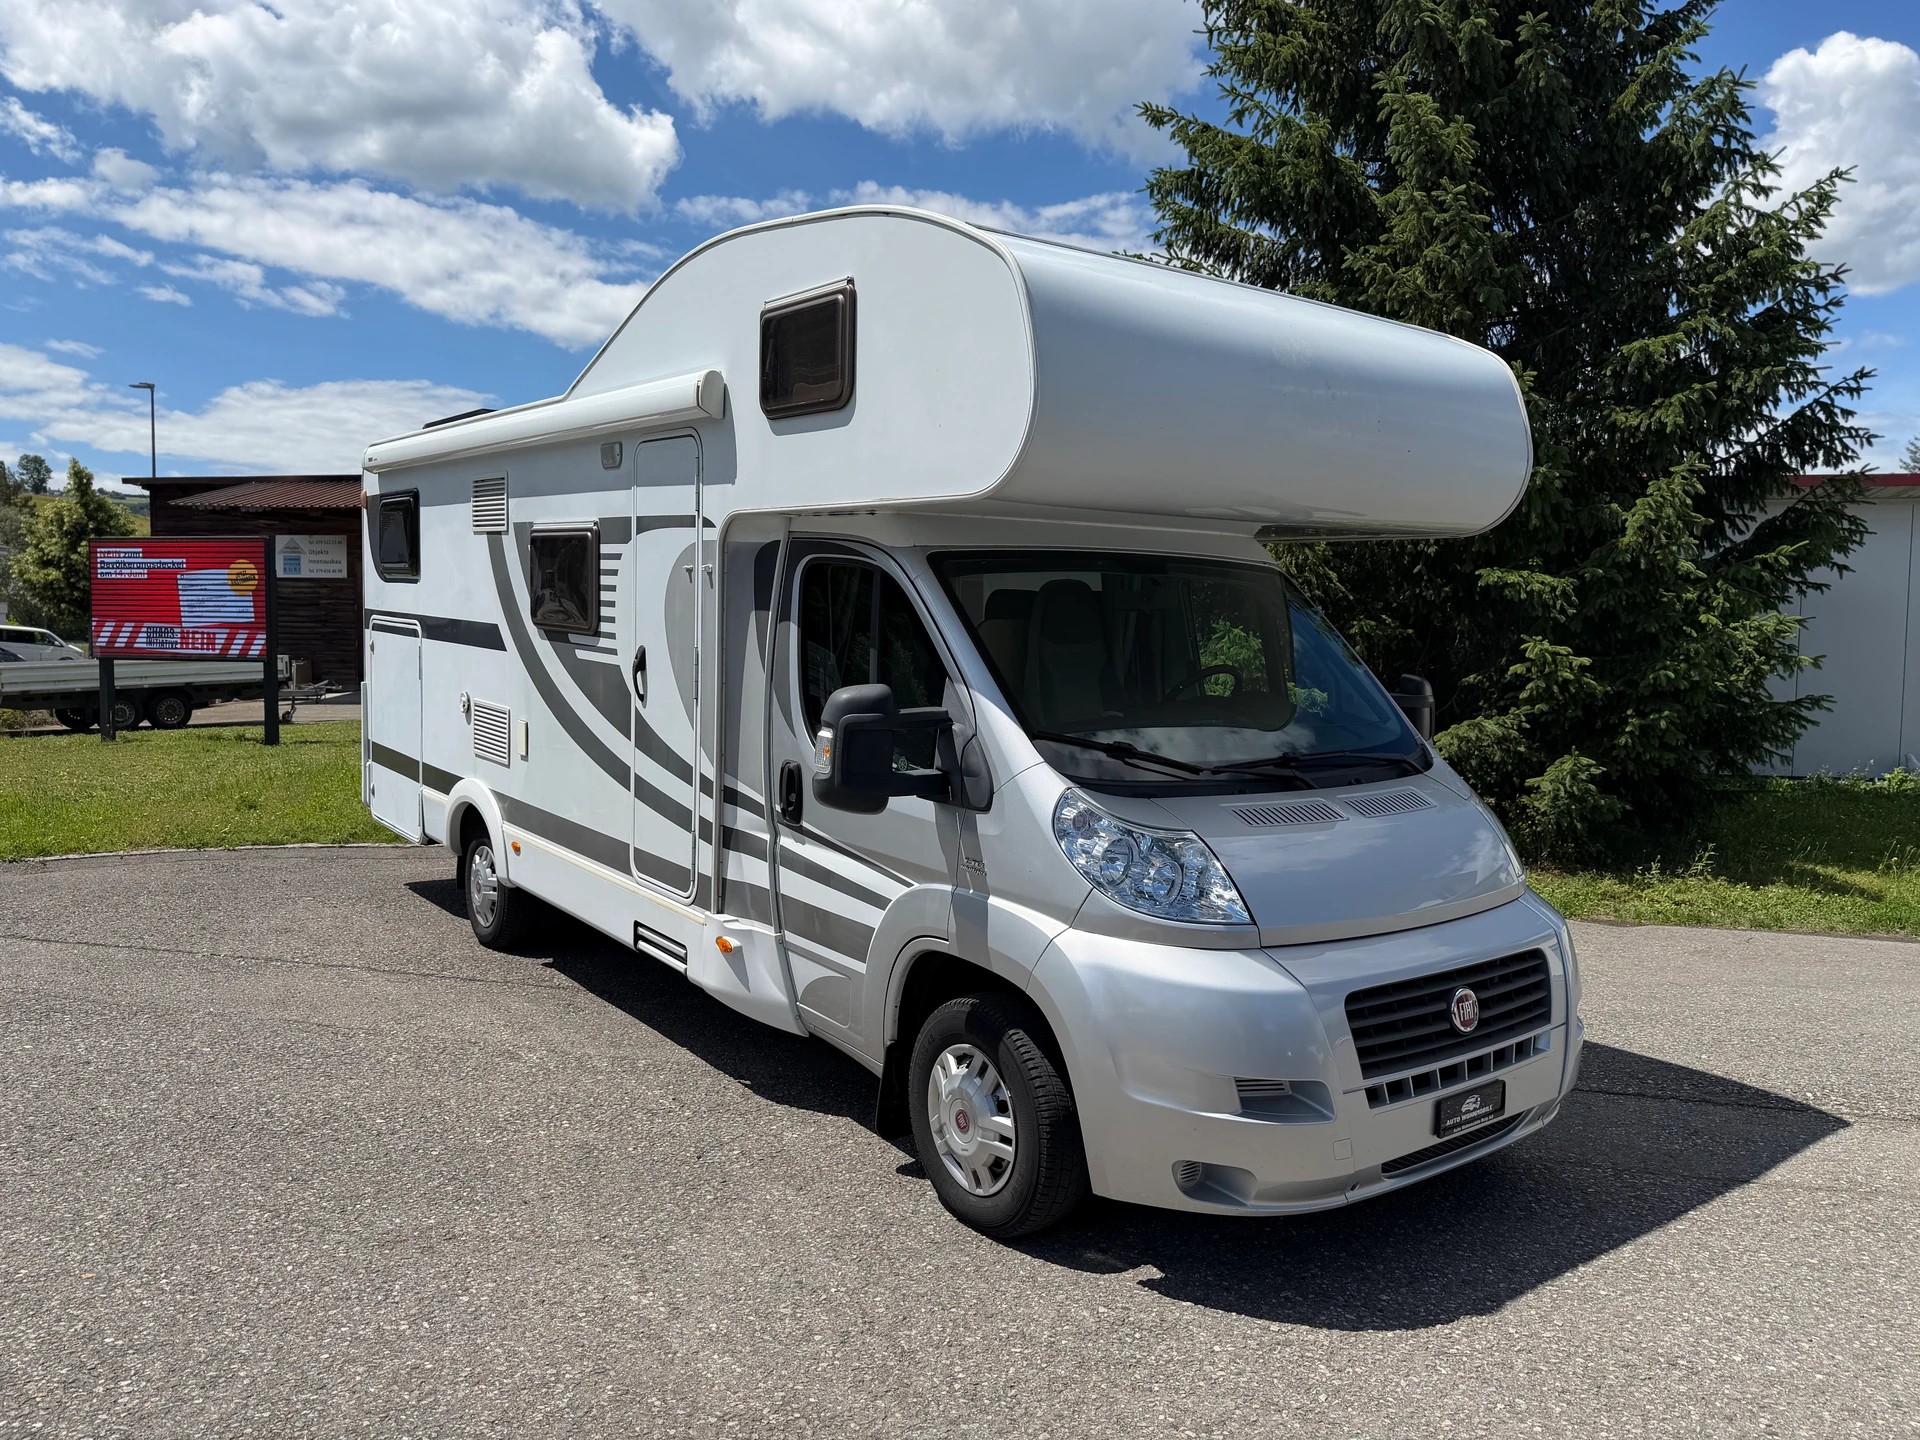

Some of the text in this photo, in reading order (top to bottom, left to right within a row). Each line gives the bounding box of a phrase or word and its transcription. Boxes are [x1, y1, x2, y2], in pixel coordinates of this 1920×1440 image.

[99, 550, 121, 558] NEIN
[180, 629, 217, 652] NEIN
[1458, 1000, 1474, 1022] FIAT
[1445, 1116, 1461, 1126] AUTO
